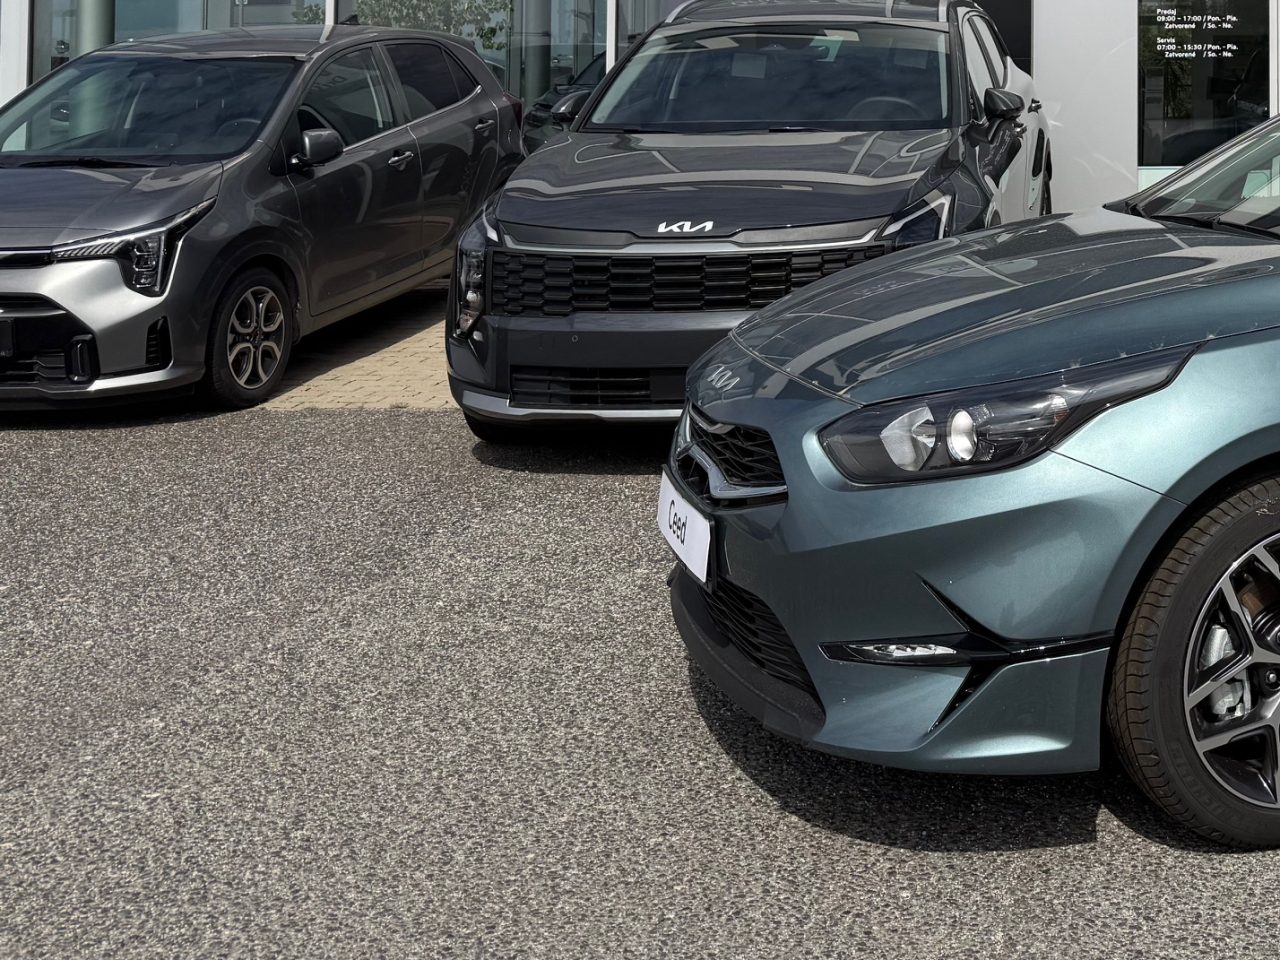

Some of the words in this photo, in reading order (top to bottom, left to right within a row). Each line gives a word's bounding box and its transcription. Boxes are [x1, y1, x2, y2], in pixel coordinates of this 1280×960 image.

[1156, 8, 1177, 16] Predaj
[657, 220, 714, 234] KIA
[706, 365, 741, 392] KIA
[667, 499, 688, 546] Ceed
